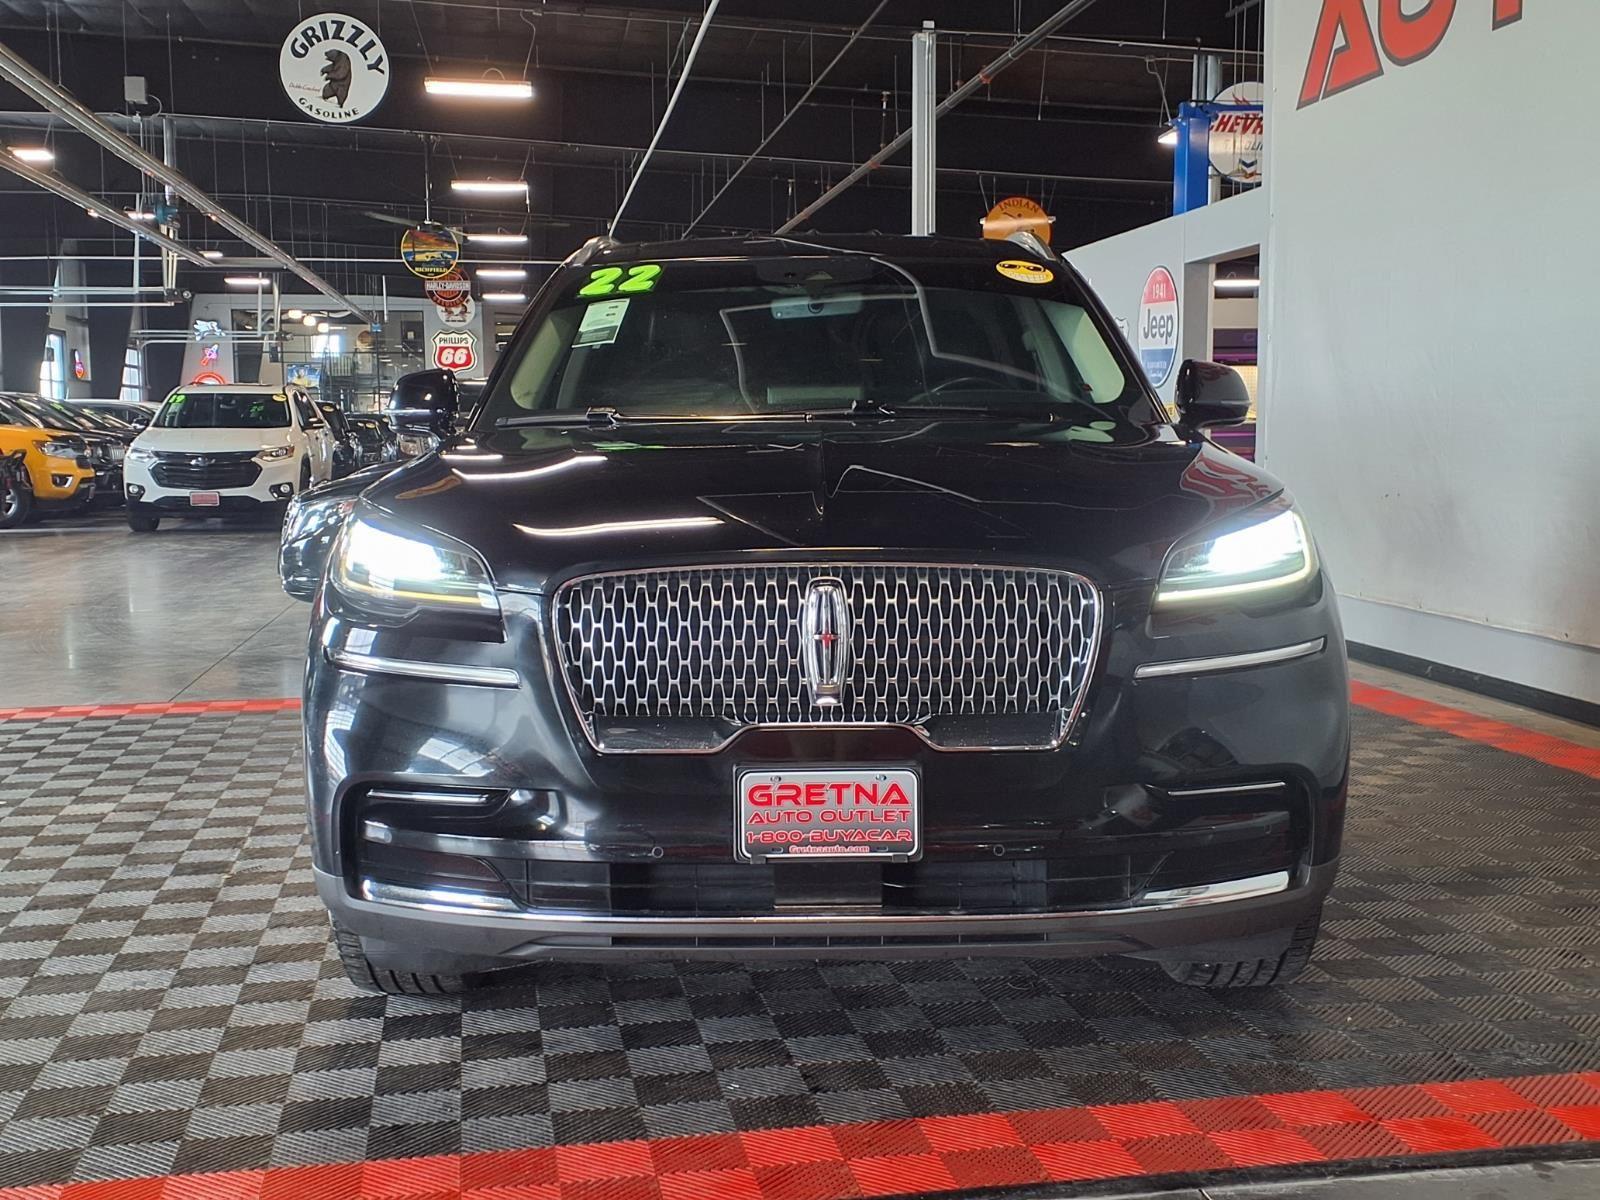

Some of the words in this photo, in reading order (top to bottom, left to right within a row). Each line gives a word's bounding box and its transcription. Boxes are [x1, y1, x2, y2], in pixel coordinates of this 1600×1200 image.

[290, 20, 384, 75] GRIZZLY
[298, 97, 360, 119] GASOLINE
[999, 199, 1039, 214] INDIAN
[579, 264, 661, 296] 22
[1152, 283, 1166, 299] 1941
[1143, 308, 1174, 345] Jeep
[438, 336, 469, 345] PHILLIPS
[440, 347, 468, 365] 66
[747, 782, 911, 807] GRETNA
[747, 809, 813, 825] AUTO
[820, 808, 912, 823] OUTLET
[746, 828, 913, 844] 1-800-BUYACAR
